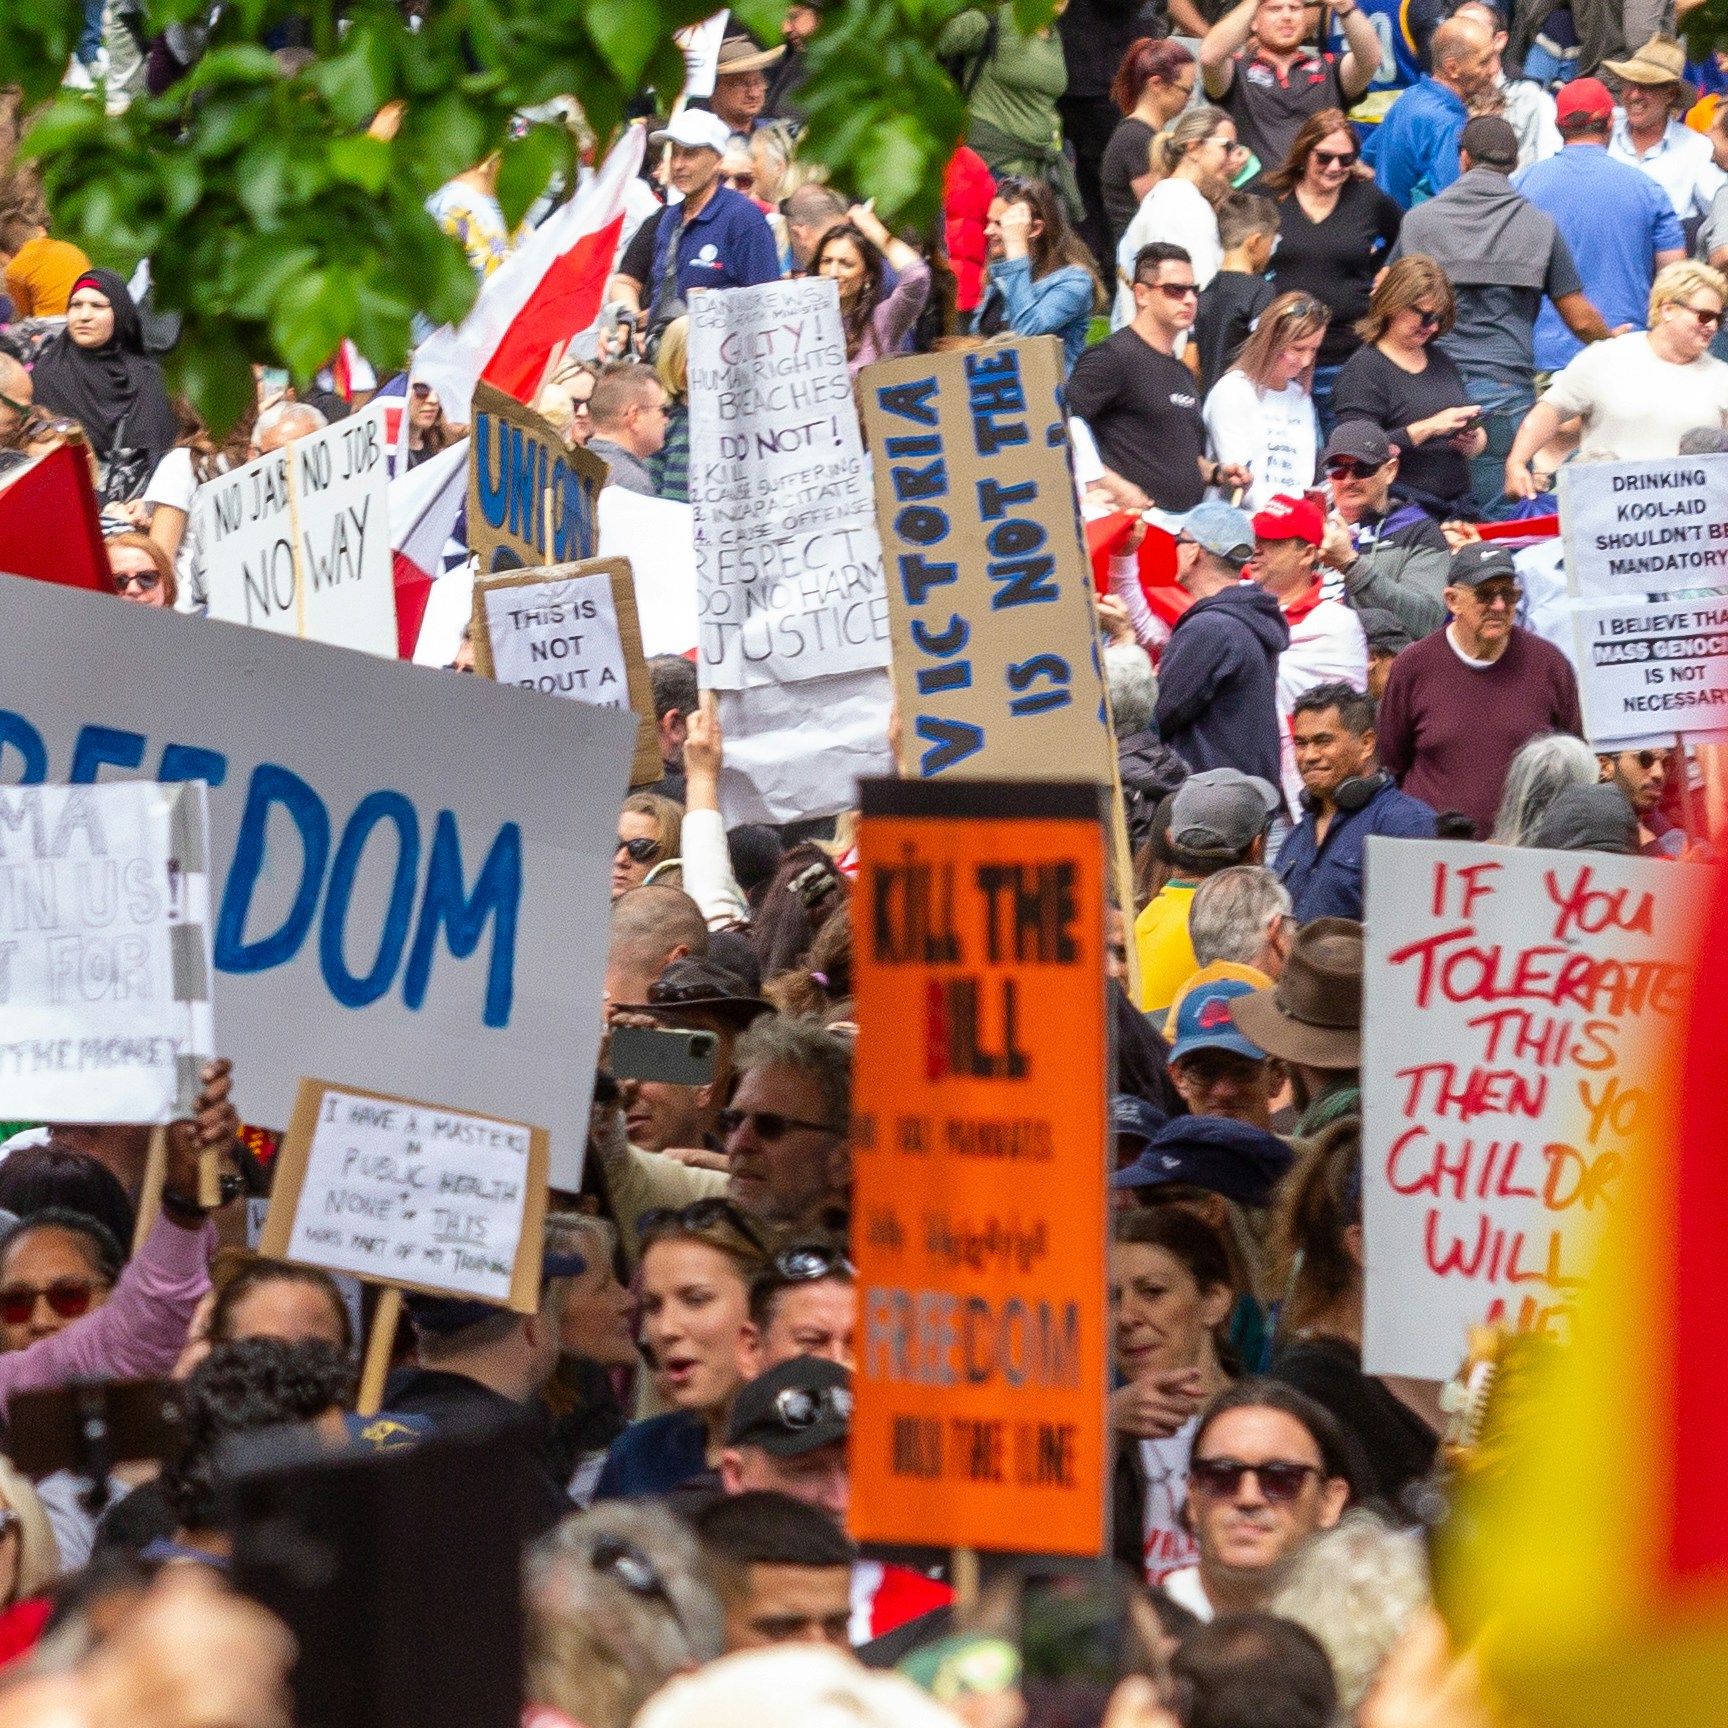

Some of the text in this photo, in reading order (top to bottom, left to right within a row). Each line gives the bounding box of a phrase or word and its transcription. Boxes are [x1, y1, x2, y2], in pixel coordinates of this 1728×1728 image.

[752, 344, 845, 381] RIGHTS
[720, 433, 749, 461] DO
[213, 419, 381, 542] NO JAB NO JOB
[1613, 469, 1707, 493] DRINKING
[964, 347, 1073, 718] IS NOT THE
[1617, 498, 1707, 522] KOOL-AID
[242, 492, 372, 625] NO WAY
[696, 527, 863, 586] RESPECT
[1595, 524, 1703, 551] SHOULDN'T
[877, 375, 985, 777] VICTORIA
[1609, 548, 1728, 576] MANDATORY
[507, 599, 597, 632] THIS IS
[745, 582, 792, 618] NO
[704, 595, 890, 665] JUSTICE
[1611, 613, 1689, 636] BELIEVE
[530, 634, 588, 664] NOT
[1594, 640, 1650, 665] MASS
[598, 665, 619, 686] A
[1644, 664, 1707, 685] IS NOT
[80, 854, 183, 930] US!
[977, 859, 1080, 964] THE
[1432, 860, 1504, 920] IF
[46, 932, 153, 1003] FOR
[1389, 926, 1698, 1017] TOLERATE
[1468, 1008, 1620, 1073] THIS
[1395, 1061, 1546, 1123] THEN
[432, 1208, 488, 1239] THIS
[1424, 1208, 1587, 1289] WILL
